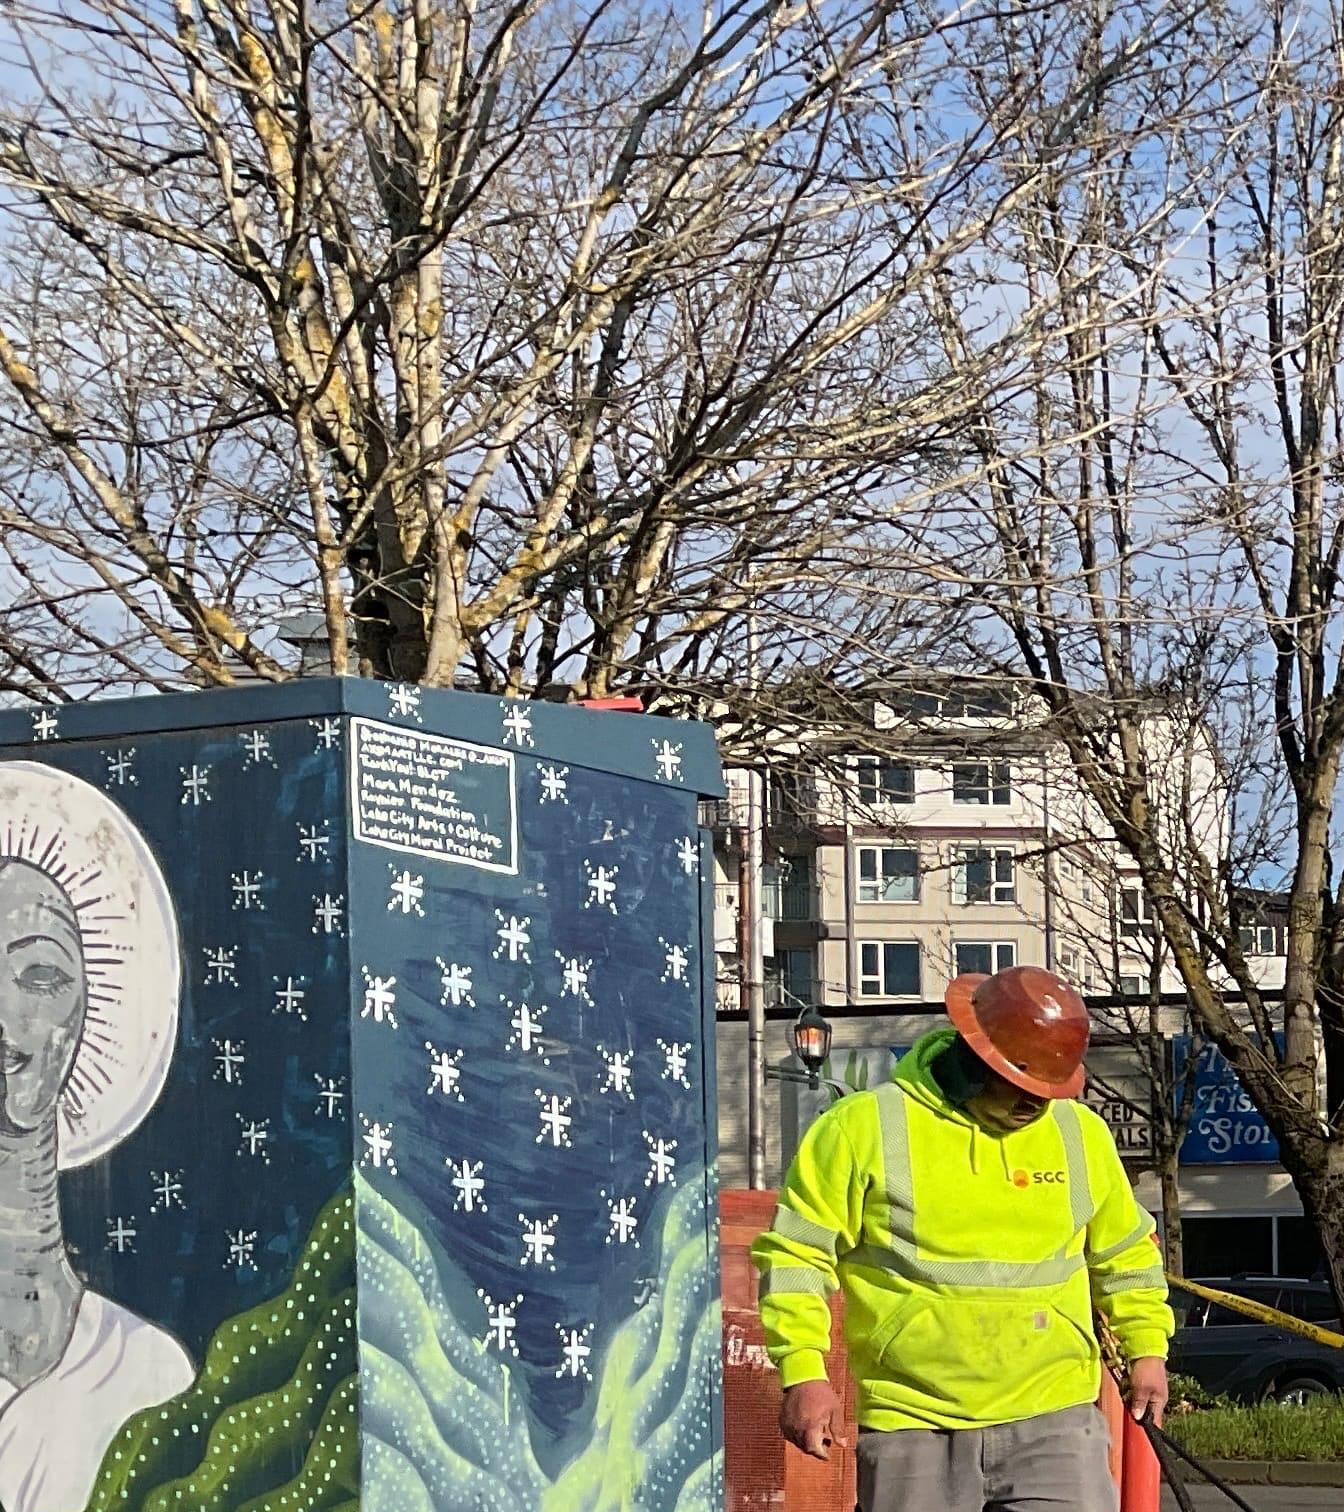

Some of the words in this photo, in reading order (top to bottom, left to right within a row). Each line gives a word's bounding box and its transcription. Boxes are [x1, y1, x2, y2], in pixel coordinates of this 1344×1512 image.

[389, 810, 414, 830] City
[1197, 1085, 1258, 1114] Fis
[1033, 1171, 1065, 1184] SGC
